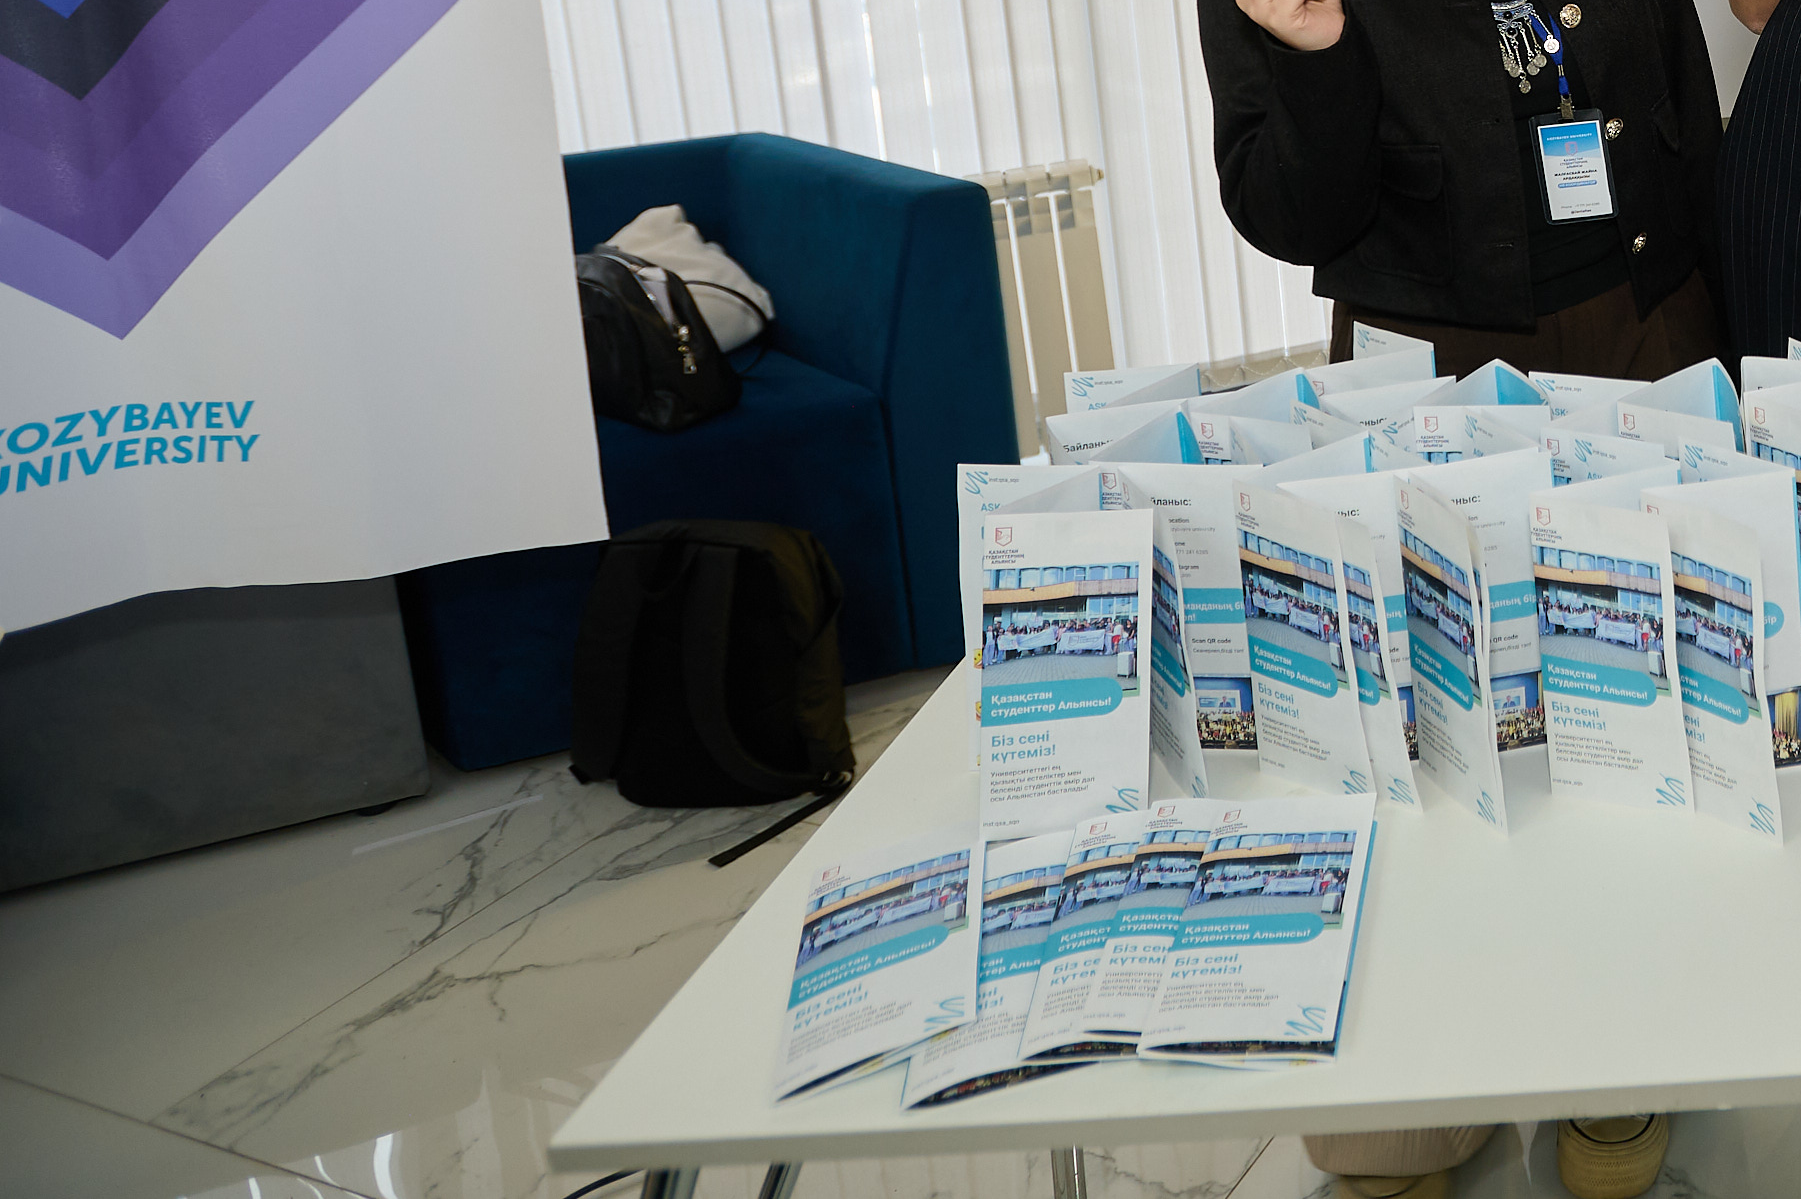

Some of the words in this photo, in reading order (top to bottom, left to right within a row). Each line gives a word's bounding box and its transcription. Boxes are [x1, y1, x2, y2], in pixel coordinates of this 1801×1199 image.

[1254, 645, 1292, 666] Қазақстан
[1255, 657, 1295, 679] студенттер
[1296, 671, 1331, 691] Альянсы!
[1547, 663, 1597, 680] Қазақстан
[1258, 682, 1272, 696] Біз
[1274, 690, 1294, 705] сені
[1548, 677, 1601, 693] студенттер
[1602, 685, 1648, 700] Альянсы!
[991, 691, 1053, 705] Қазақстан
[1703, 694, 1742, 718] Альянсы!
[991, 704, 1055, 719] студенттер
[1058, 697, 1112, 710] Альянсы!
[1259, 697, 1299, 719] күтеміз!
[1551, 701, 1570, 713] Біз
[1574, 706, 1599, 718] сені
[1553, 716, 1607, 731] күтеміз!
[991, 735, 1014, 748] Біз
[1018, 730, 1050, 745] сені
[991, 744, 1056, 764] күтеміз!
[990, 766, 1050, 778] Университеттегі
[1122, 913, 1183, 923] Қазақста
[1181, 933, 1250, 944] студенттер
[1252, 929, 1311, 940] Альянсы!
[1185, 923, 1250, 935] Қазақстан
[1113, 945, 1138, 954] Біз
[1053, 961, 1078, 975] Біз
[1174, 956, 1200, 967] Біз
[1203, 953, 1239, 965] сені
[1171, 964, 1243, 979] күтеміз!
